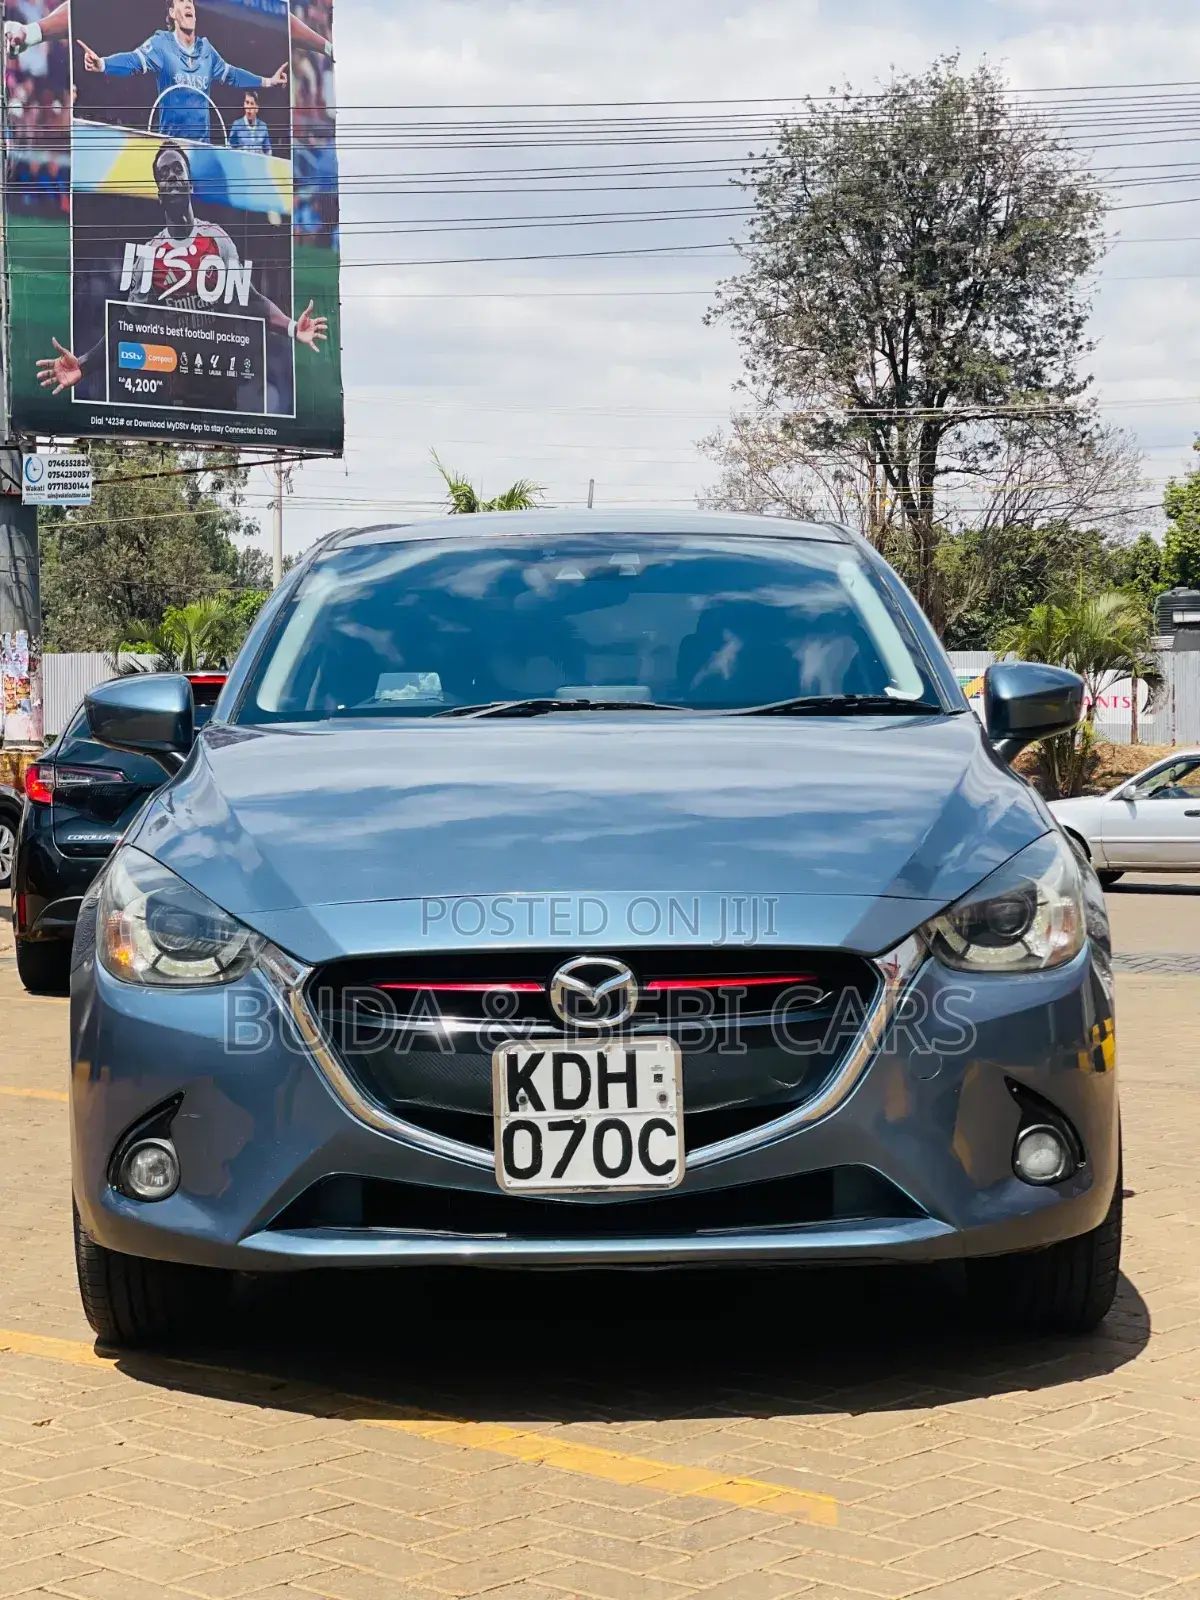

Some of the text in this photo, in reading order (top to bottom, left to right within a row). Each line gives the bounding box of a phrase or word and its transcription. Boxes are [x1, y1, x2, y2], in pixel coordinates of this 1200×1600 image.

[119, 242, 253, 307] IT'S ON
[118, 320, 250, 346] The world's best football package
[121, 351, 173, 364] DStv Compact
[124, 378, 157, 393] 4,200
[90, 416, 104, 425] Dial
[133, 419, 166, 429] Download
[166, 421, 189, 431] MyDStv
[190, 423, 203, 433] App
[203, 423, 211, 431] to
[211, 424, 224, 434] stay
[224, 425, 257, 435] Connected
[257, 427, 264, 435] to
[264, 428, 278, 436] DStv
[47, 470, 90, 479] 0754230057
[47, 482, 90, 490] 0771830144
[506, 1050, 638, 1112] KDH
[502, 1117, 677, 1180] 070C
